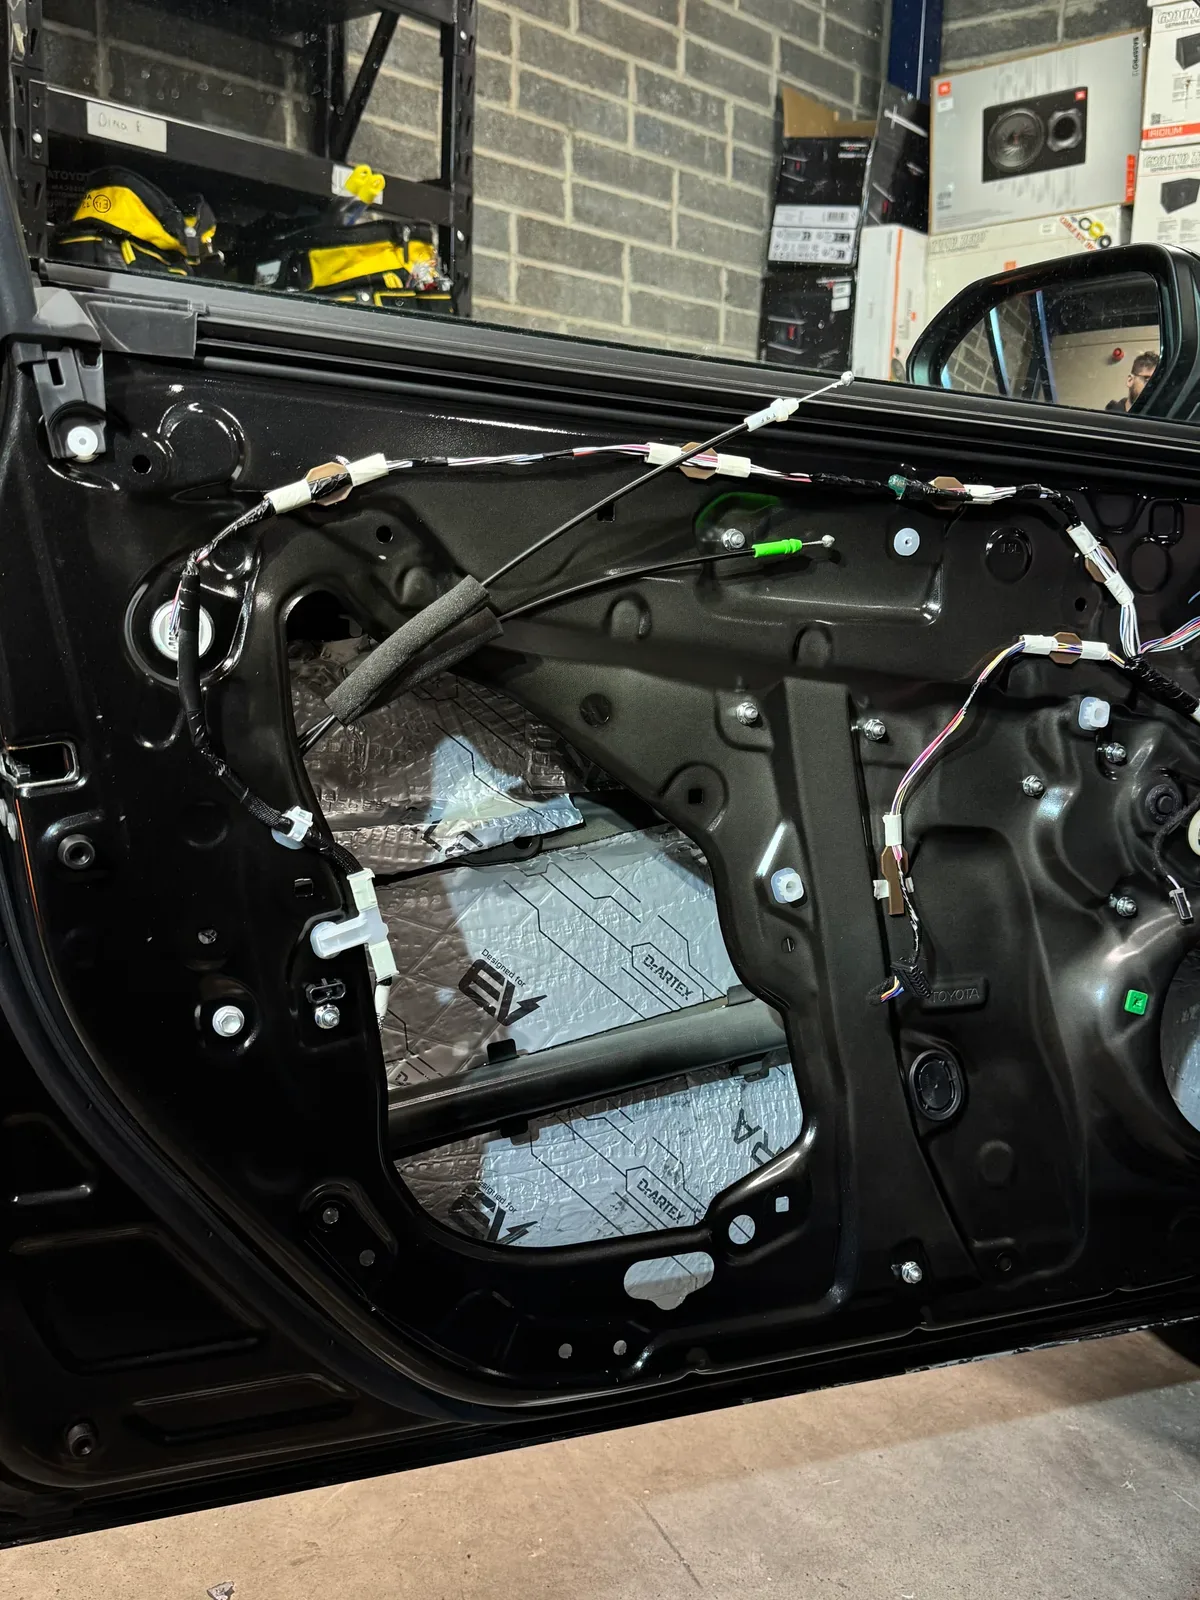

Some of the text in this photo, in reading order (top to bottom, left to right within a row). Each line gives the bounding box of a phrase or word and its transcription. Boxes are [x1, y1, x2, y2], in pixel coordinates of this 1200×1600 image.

[481, 948, 527, 988] Designed for
[458, 958, 548, 1027] EV
[933, 987, 980, 1003] TOYOTA
[505, 1202, 518, 1214] for
